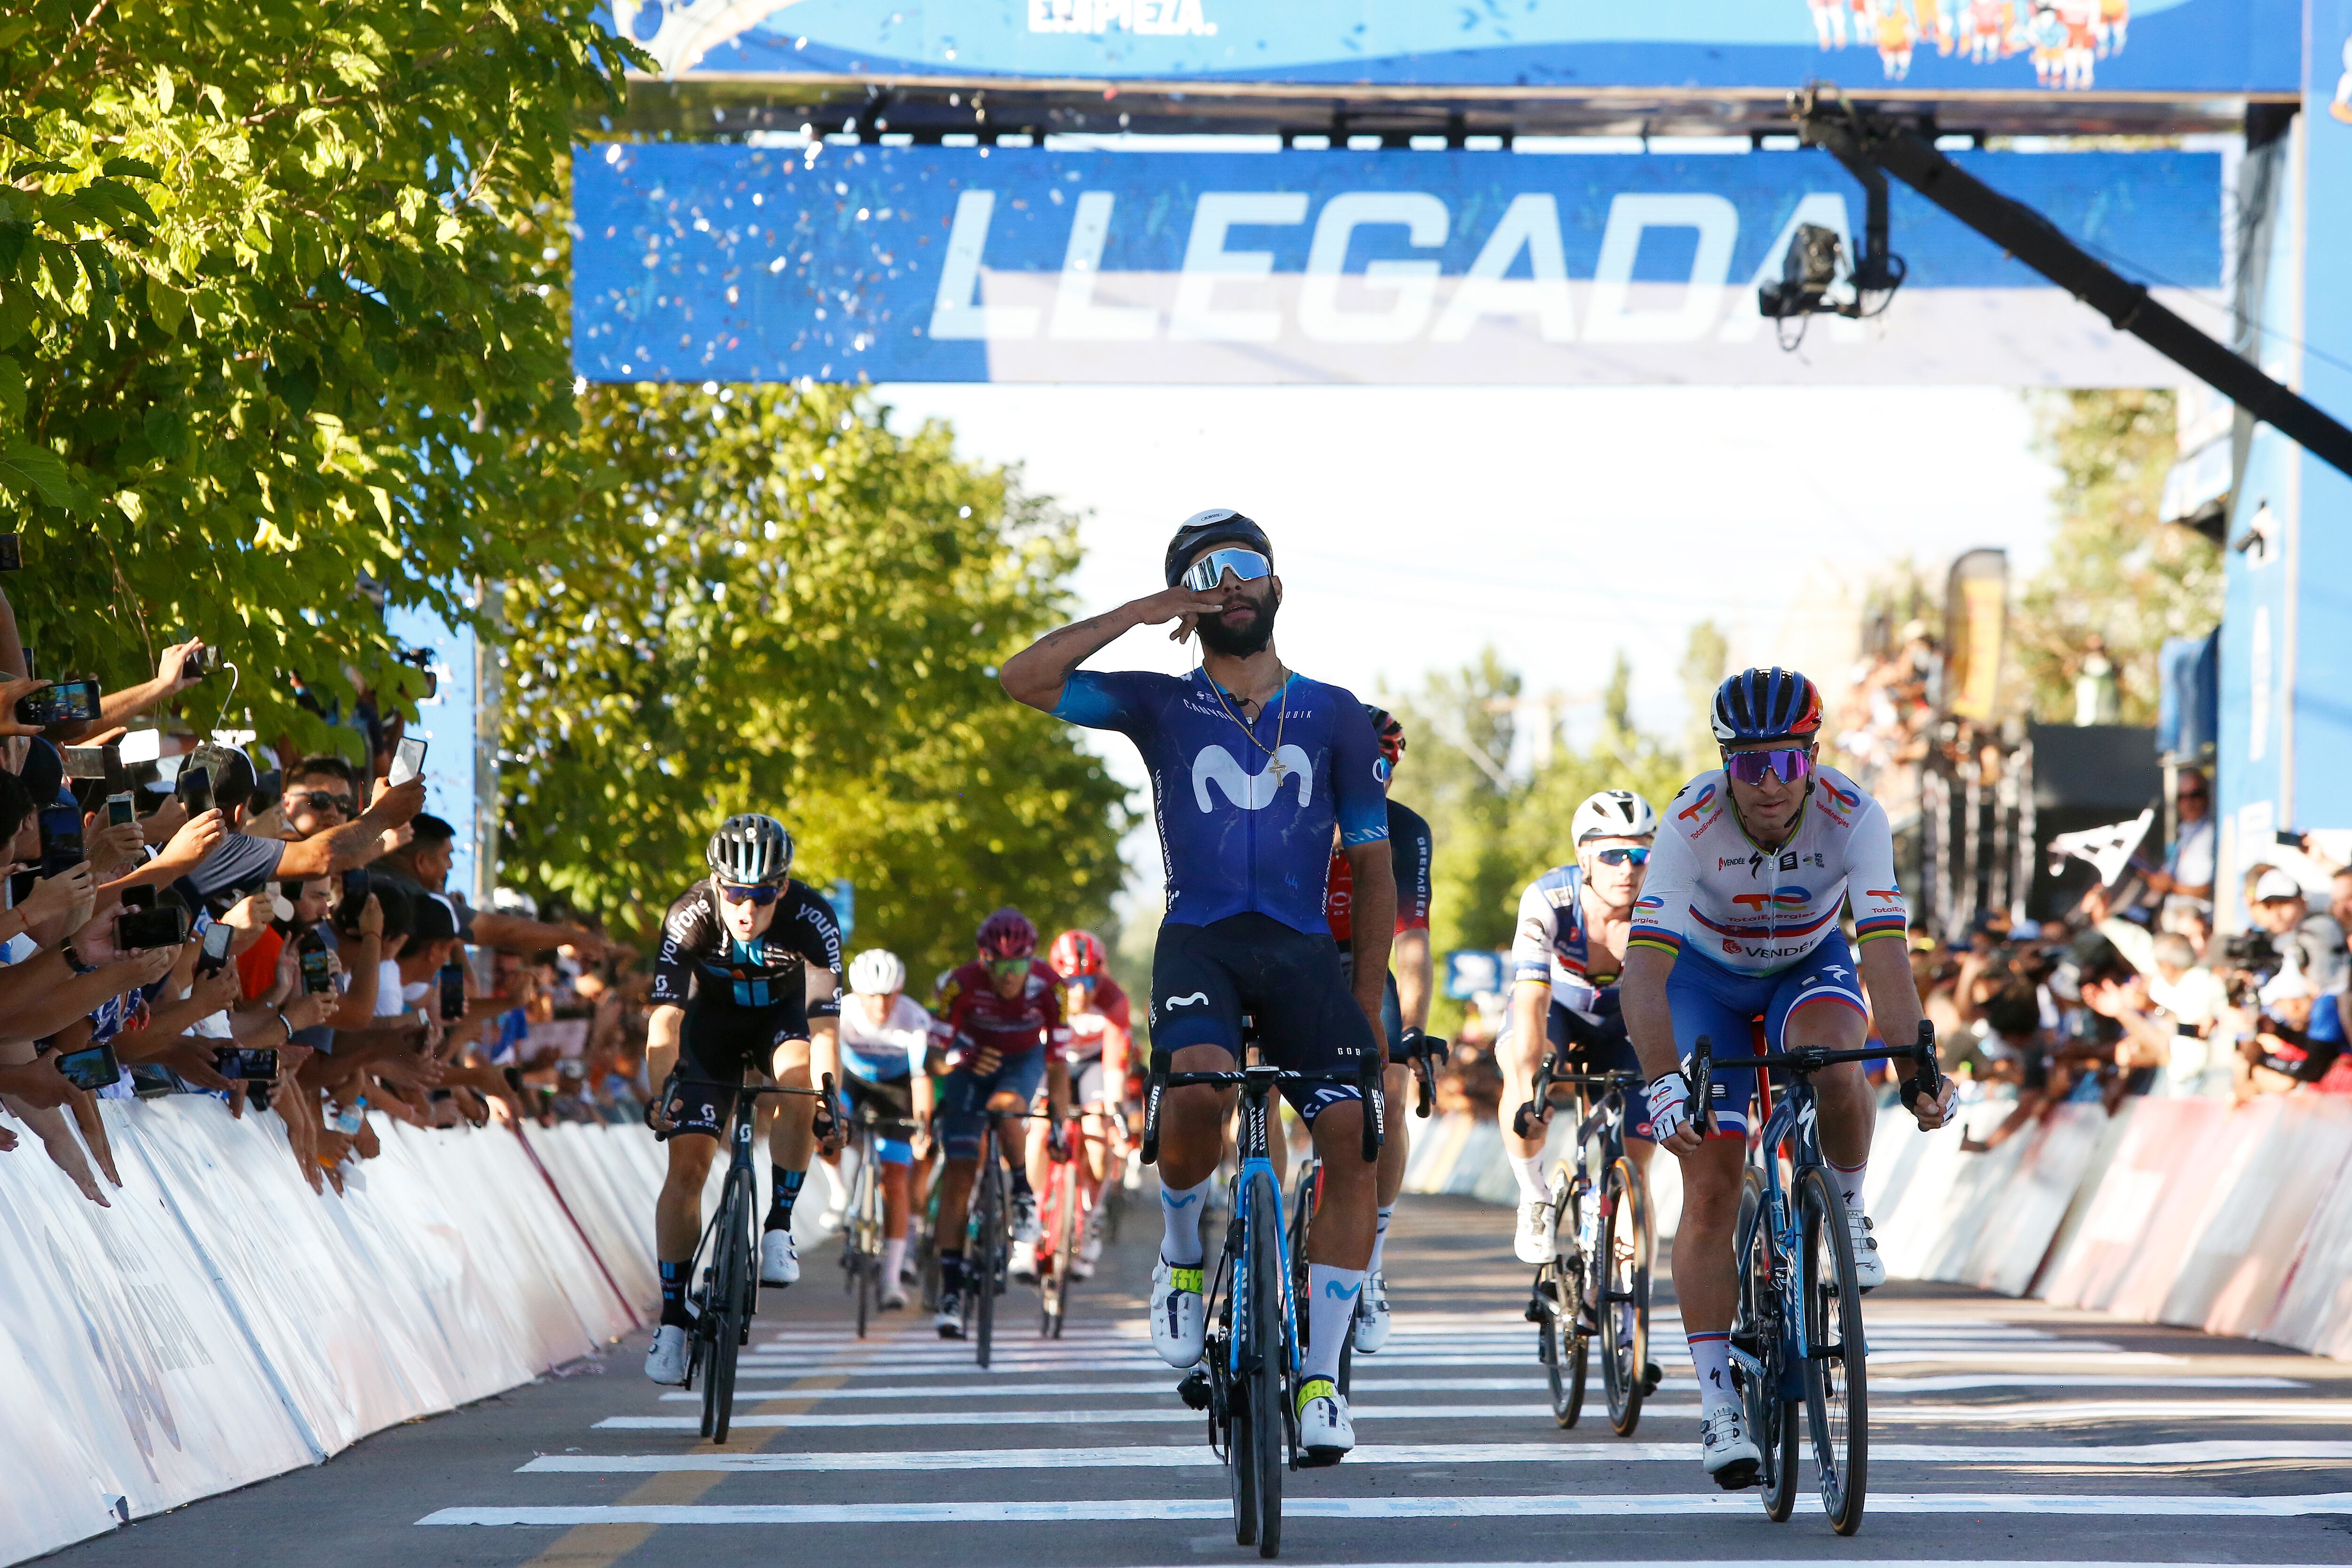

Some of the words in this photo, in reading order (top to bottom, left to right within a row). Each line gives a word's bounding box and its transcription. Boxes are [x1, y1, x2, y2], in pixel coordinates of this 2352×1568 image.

[929, 189, 1867, 346] LLEGADA
[1690, 807, 1723, 840] TotalEnergies
[1816, 800, 1850, 828] TotalEnergies
[1158, 810, 1174, 885] Telefónica
[1724, 857, 1745, 867] VENDÉE
[660, 897, 711, 966] youfone
[795, 903, 842, 974] youfone
[1746, 937, 1818, 958] VENDÉE
[1337, 1047, 1361, 1056] GOB
[1145, 1085, 1160, 1131] SRAM
[1371, 1088, 1384, 1134] SRAM
[1793, 1251, 1801, 1336] SPECIALIZED
